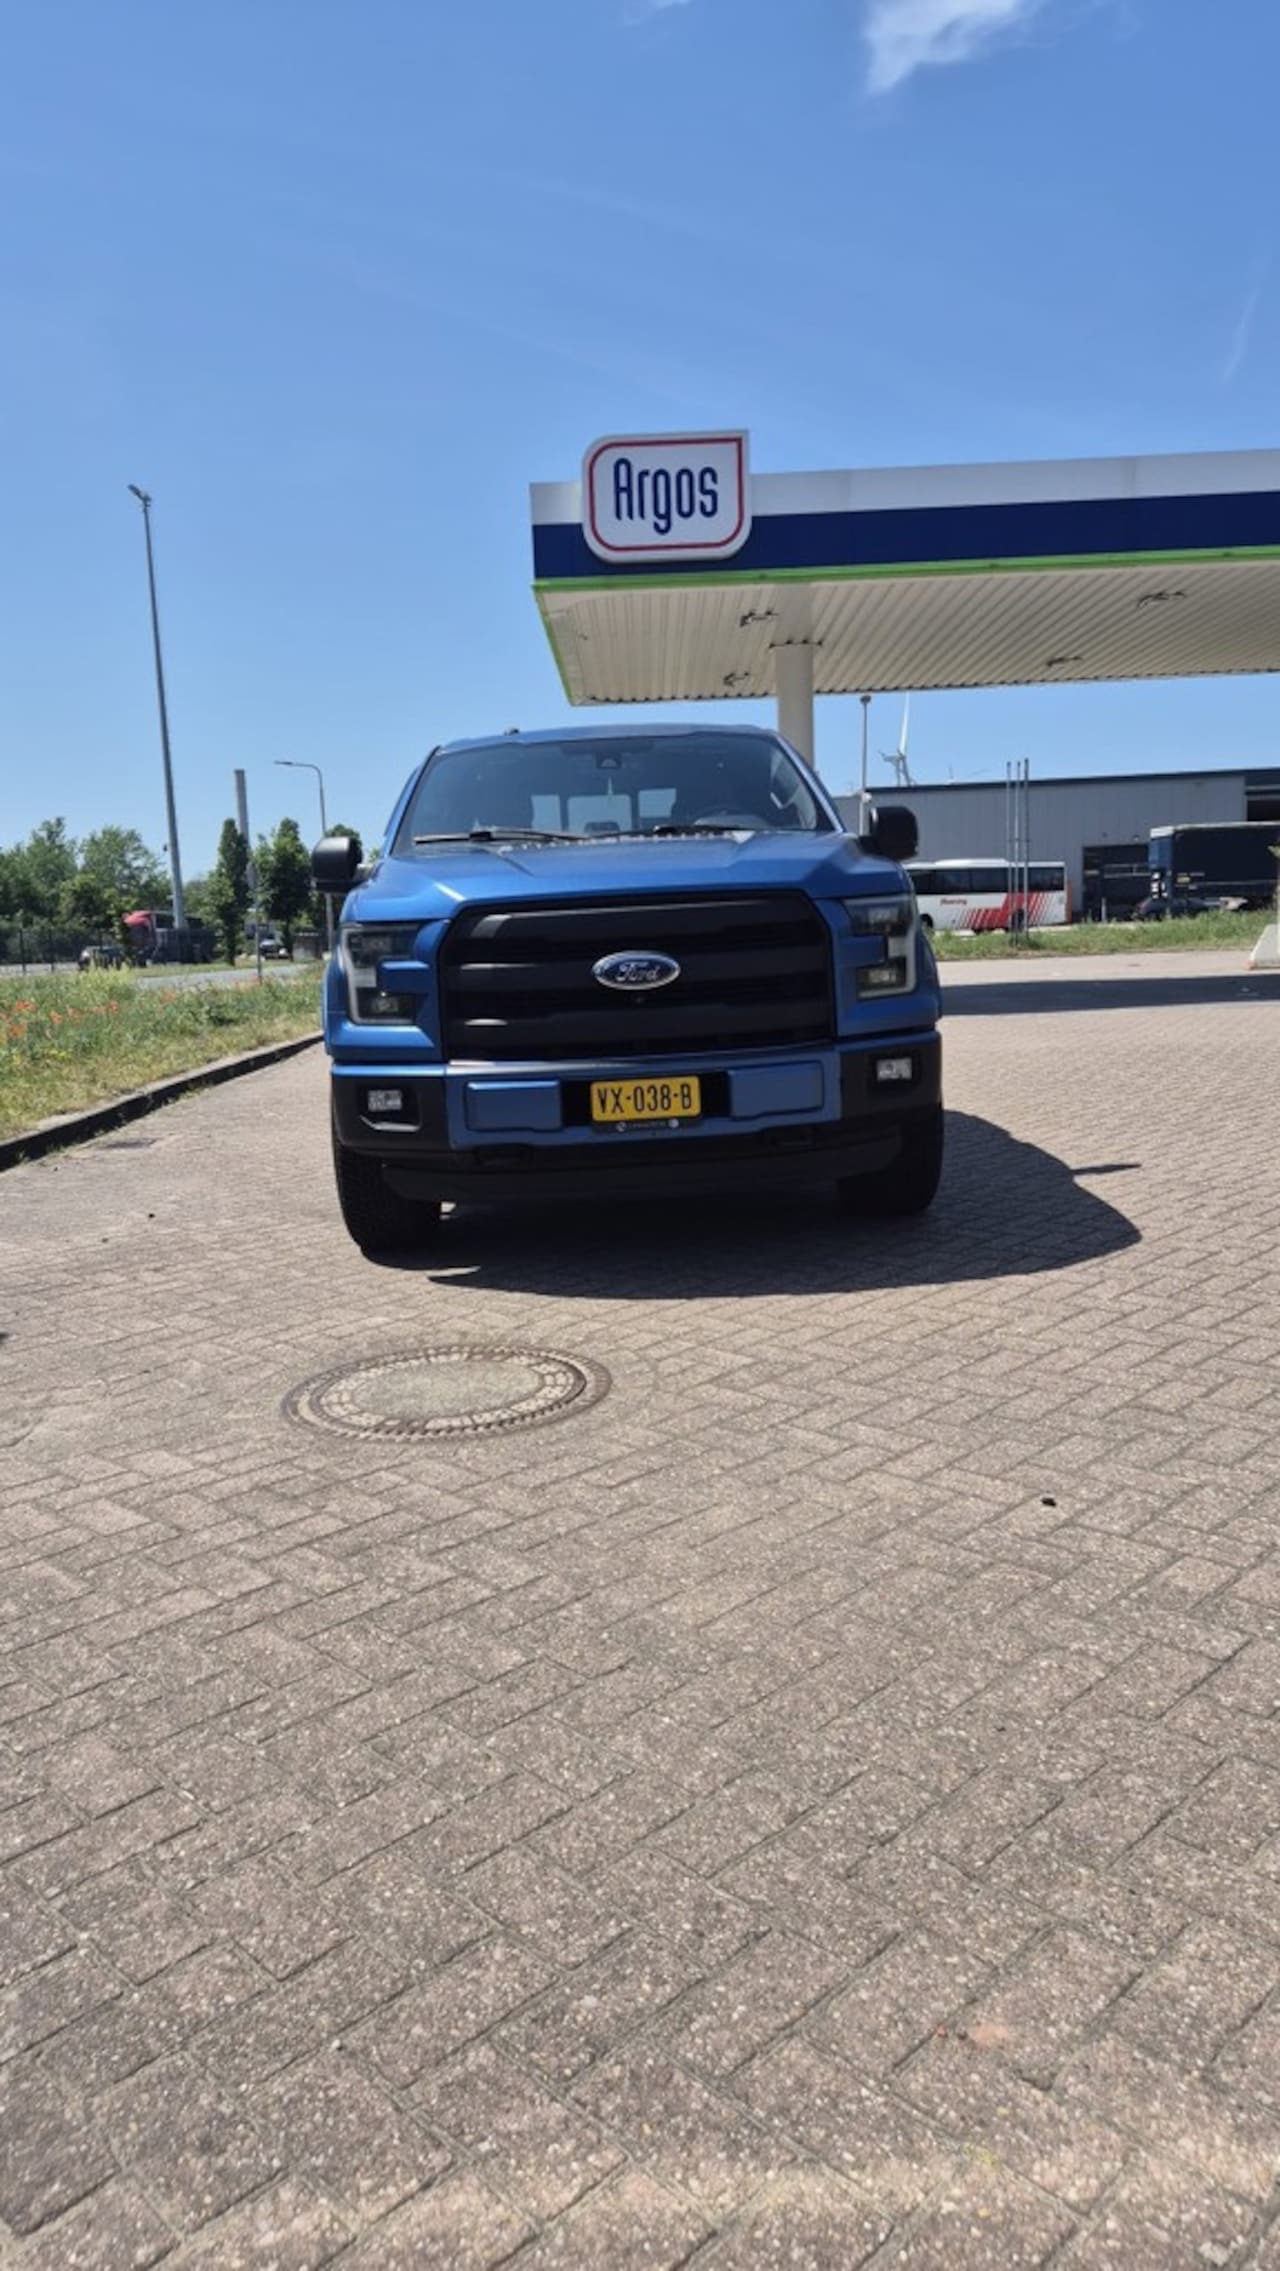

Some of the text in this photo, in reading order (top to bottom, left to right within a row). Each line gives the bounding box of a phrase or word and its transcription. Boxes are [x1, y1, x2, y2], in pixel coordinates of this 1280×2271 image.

[613, 457, 718, 535] Argos
[615, 961, 661, 982] Ford
[597, 1083, 692, 1113] VX-038-B
